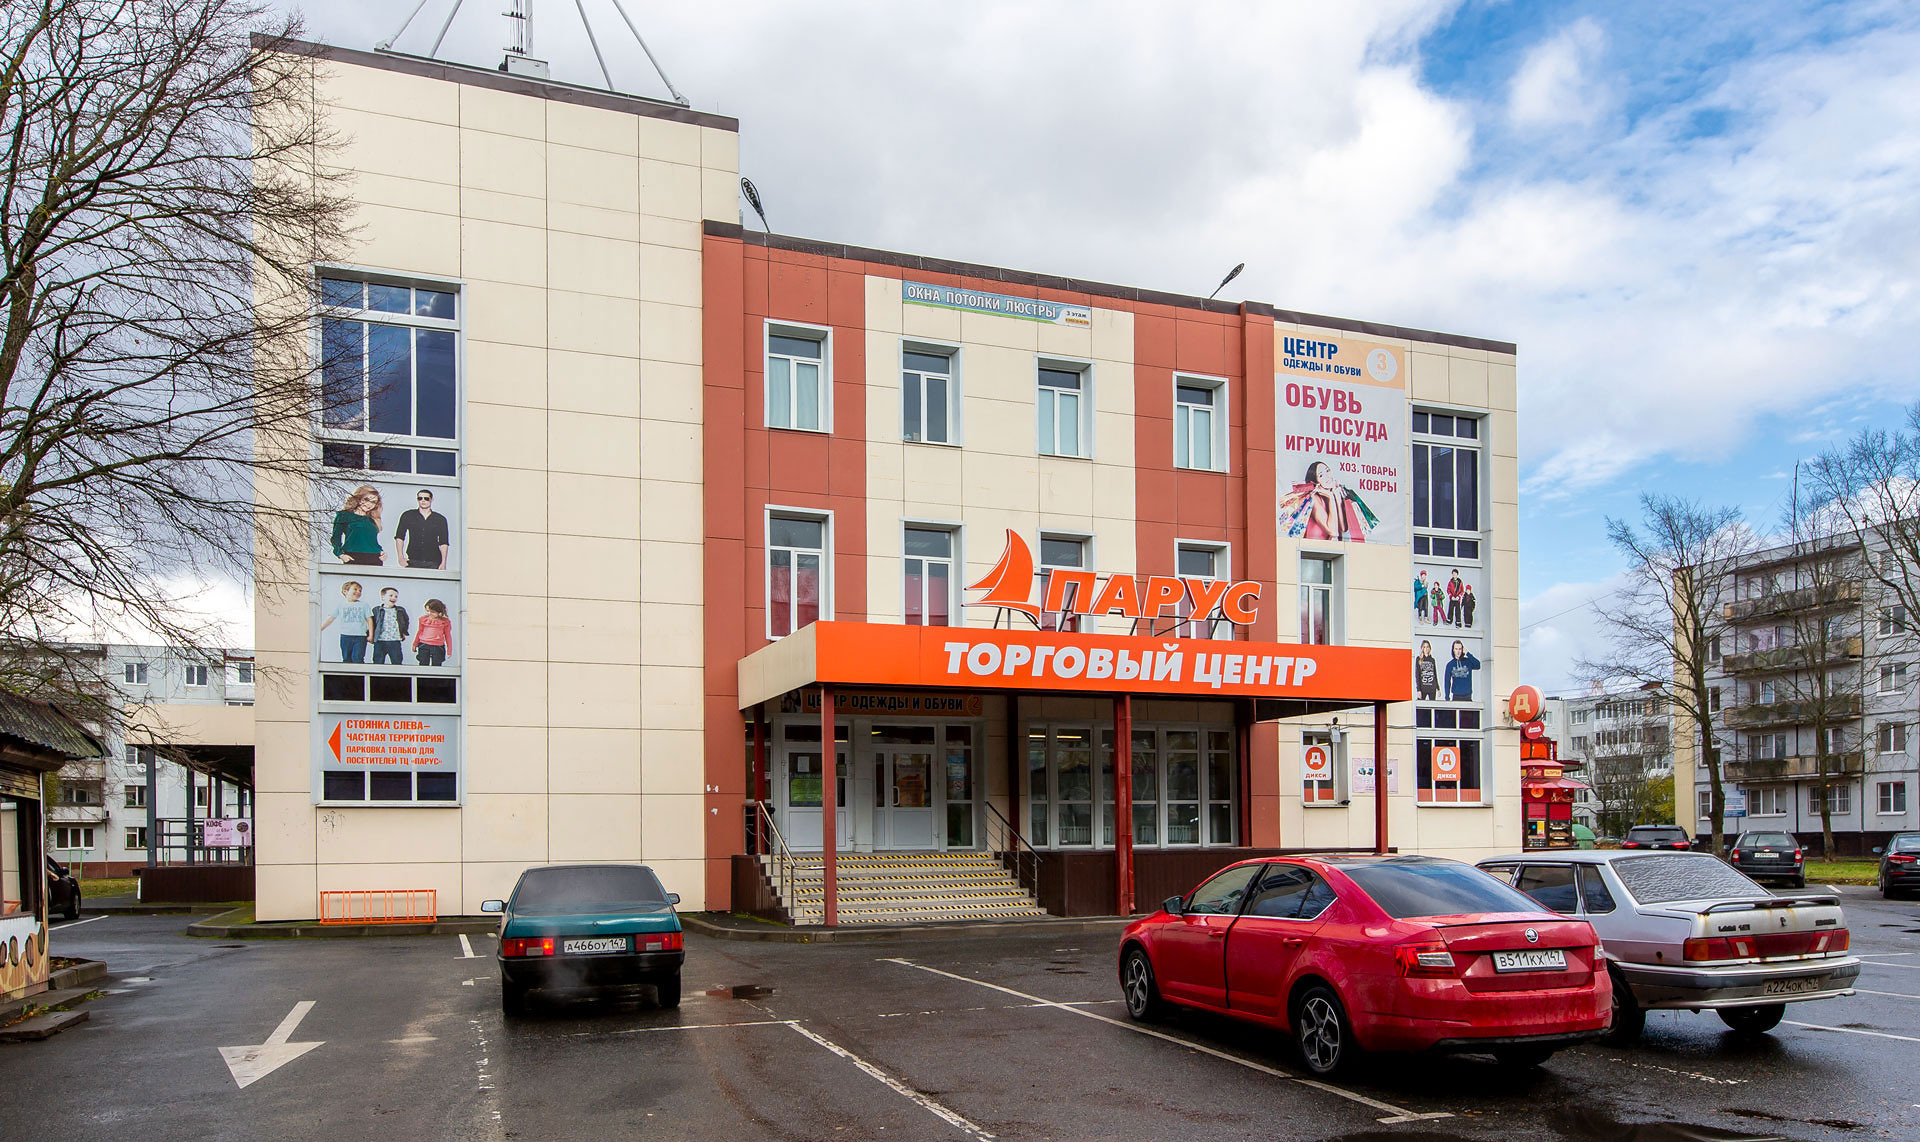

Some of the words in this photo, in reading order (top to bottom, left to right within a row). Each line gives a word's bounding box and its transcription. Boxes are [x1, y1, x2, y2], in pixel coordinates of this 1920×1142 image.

[908, 286, 941, 302] ОКНА
[946, 291, 1000, 310] ПОТОЛКИ
[1005, 301, 1056, 318] ЛЮСТРЫ
[1284, 337, 1338, 359] ЦЕНТР
[1283, 357, 1323, 372] ОДЕЖДЫ
[1326, 363, 1331, 373] И
[1334, 365, 1361, 376] ОБУВИ
[1376, 352, 1387, 370] 3
[1285, 383, 1362, 414] ОБУВЬ
[1319, 415, 1388, 443] ПОСУДА
[1285, 435, 1361, 457] ИГРУШКИ
[1339, 462, 1360, 473] ХОЗ.
[1361, 464, 1397, 477] ТОВАРЫ
[1359, 478, 1397, 493] КОВРЫ
[1043, 568, 1262, 625] ПАРУС
[944, 642, 1185, 682] ТОРГОВЫЙ
[1193, 653, 1317, 689] ЦЕНТР
[808, 694, 847, 708] ЦЕТР
[852, 694, 908, 711] ОДЕЖДЫ
[911, 697, 920, 710] И
[924, 697, 963, 711] ОБУВИ
[1514, 694, 1531, 715] Д
[346, 719, 390, 730] СТОЯНКА
[346, 733, 386, 742] ЧАСТНАЯ
[388, 733, 445, 743] ТЕРРИТОРИЯ!
[346, 745, 386, 754] ПАРКОВКА
[388, 746, 417, 754] ТОЛЬКО
[419, 747, 434, 755] ДЛЯ
[1310, 752, 1322, 765] Д
[346, 756, 397, 765] ПОСЕТИТЕЛЕЙ
[399, 757, 409, 766] ТЦ
[1441, 754, 1452, 766] Д
